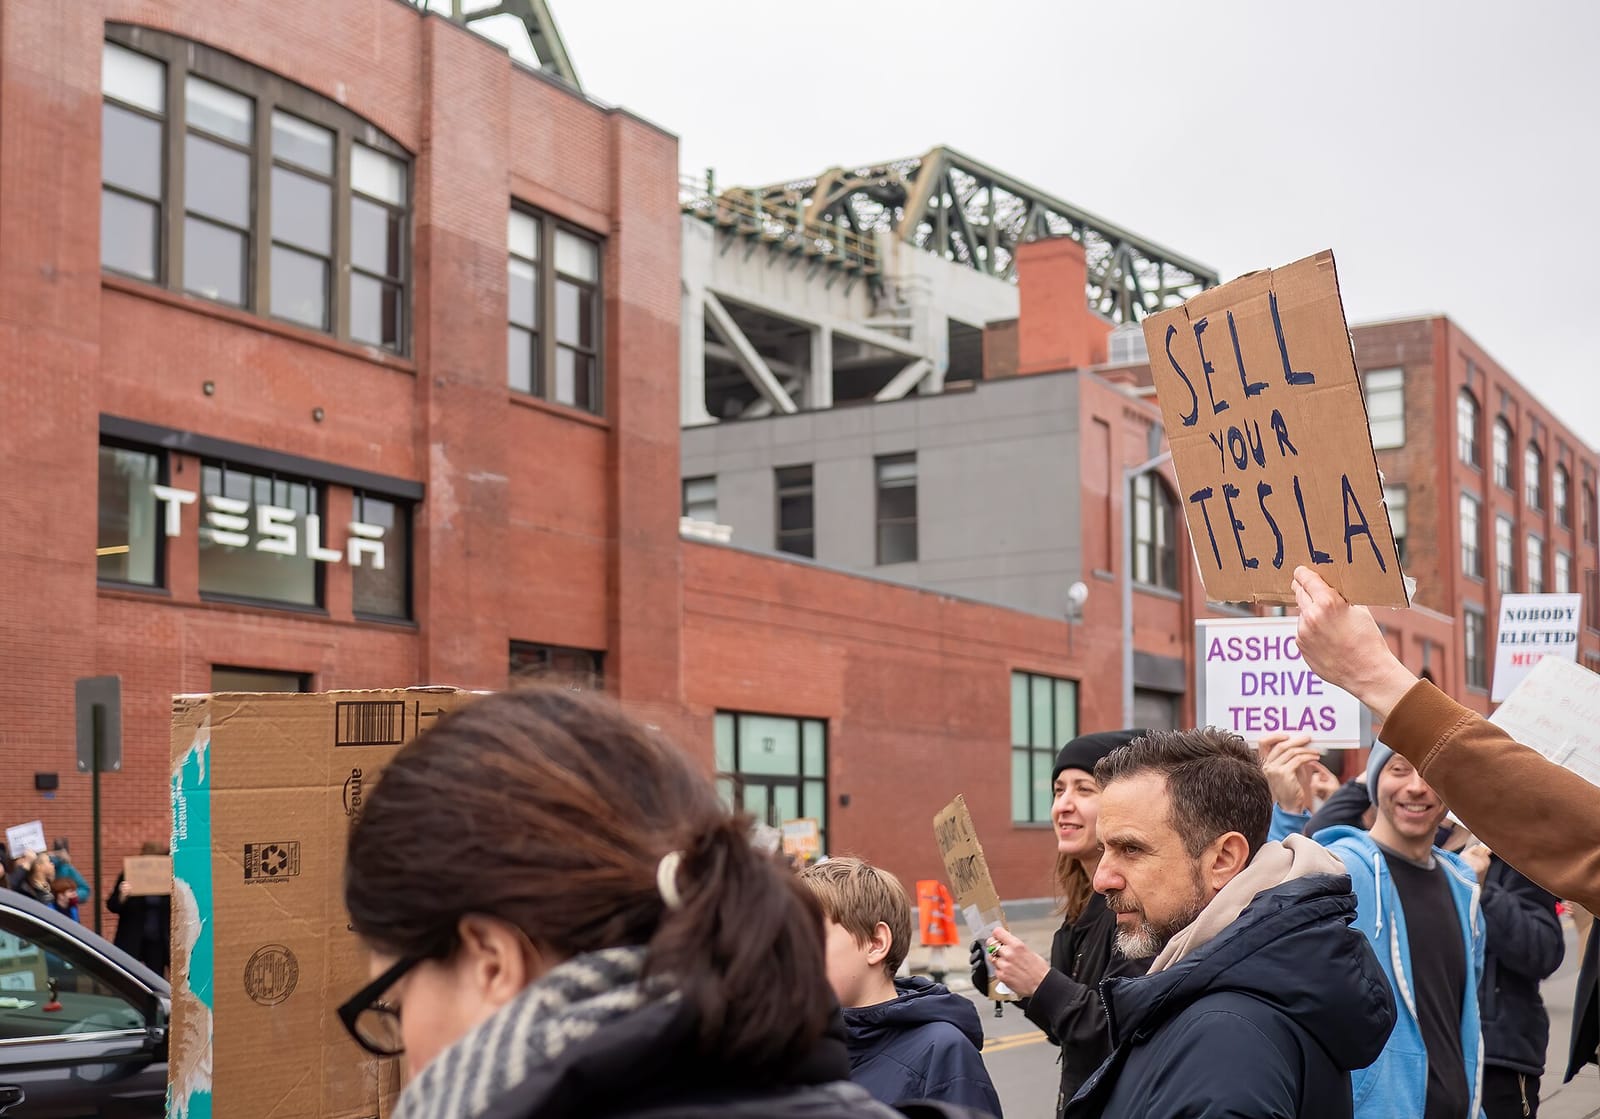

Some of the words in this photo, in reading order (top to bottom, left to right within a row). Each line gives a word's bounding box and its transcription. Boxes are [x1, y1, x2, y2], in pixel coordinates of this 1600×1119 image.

[1165, 289, 1316, 427] SELL
[1208, 408, 1298, 474] YOUR
[151, 484, 386, 570] TESLA
[1189, 473, 1387, 574] TESLA
[1504, 607, 1576, 622] NOBODY
[1206, 636, 1302, 662] ASSHO
[1500, 630, 1577, 644] ELECTED
[1511, 652, 1544, 667] MU
[1241, 670, 1324, 696] DRIVE
[1228, 706, 1337, 732] TESLAS
[351, 768, 362, 825] amazo
[178, 796, 188, 840] amazon
